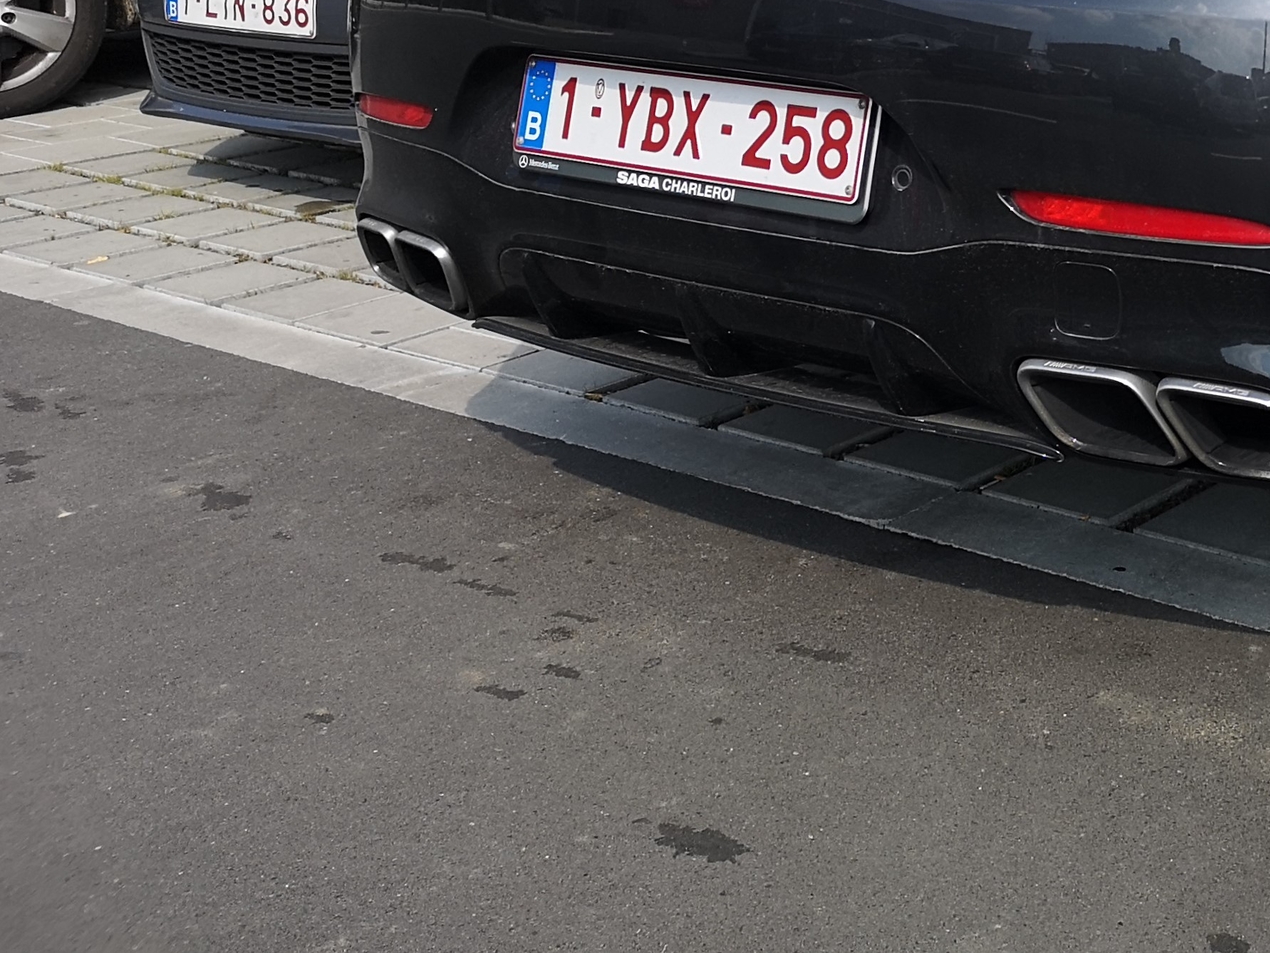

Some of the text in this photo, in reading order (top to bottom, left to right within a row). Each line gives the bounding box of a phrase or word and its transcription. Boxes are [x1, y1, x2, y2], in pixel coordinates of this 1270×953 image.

[523, 76, 854, 180] B 1-YBX-258
[616, 170, 736, 202] SAGA CHARLEROI
